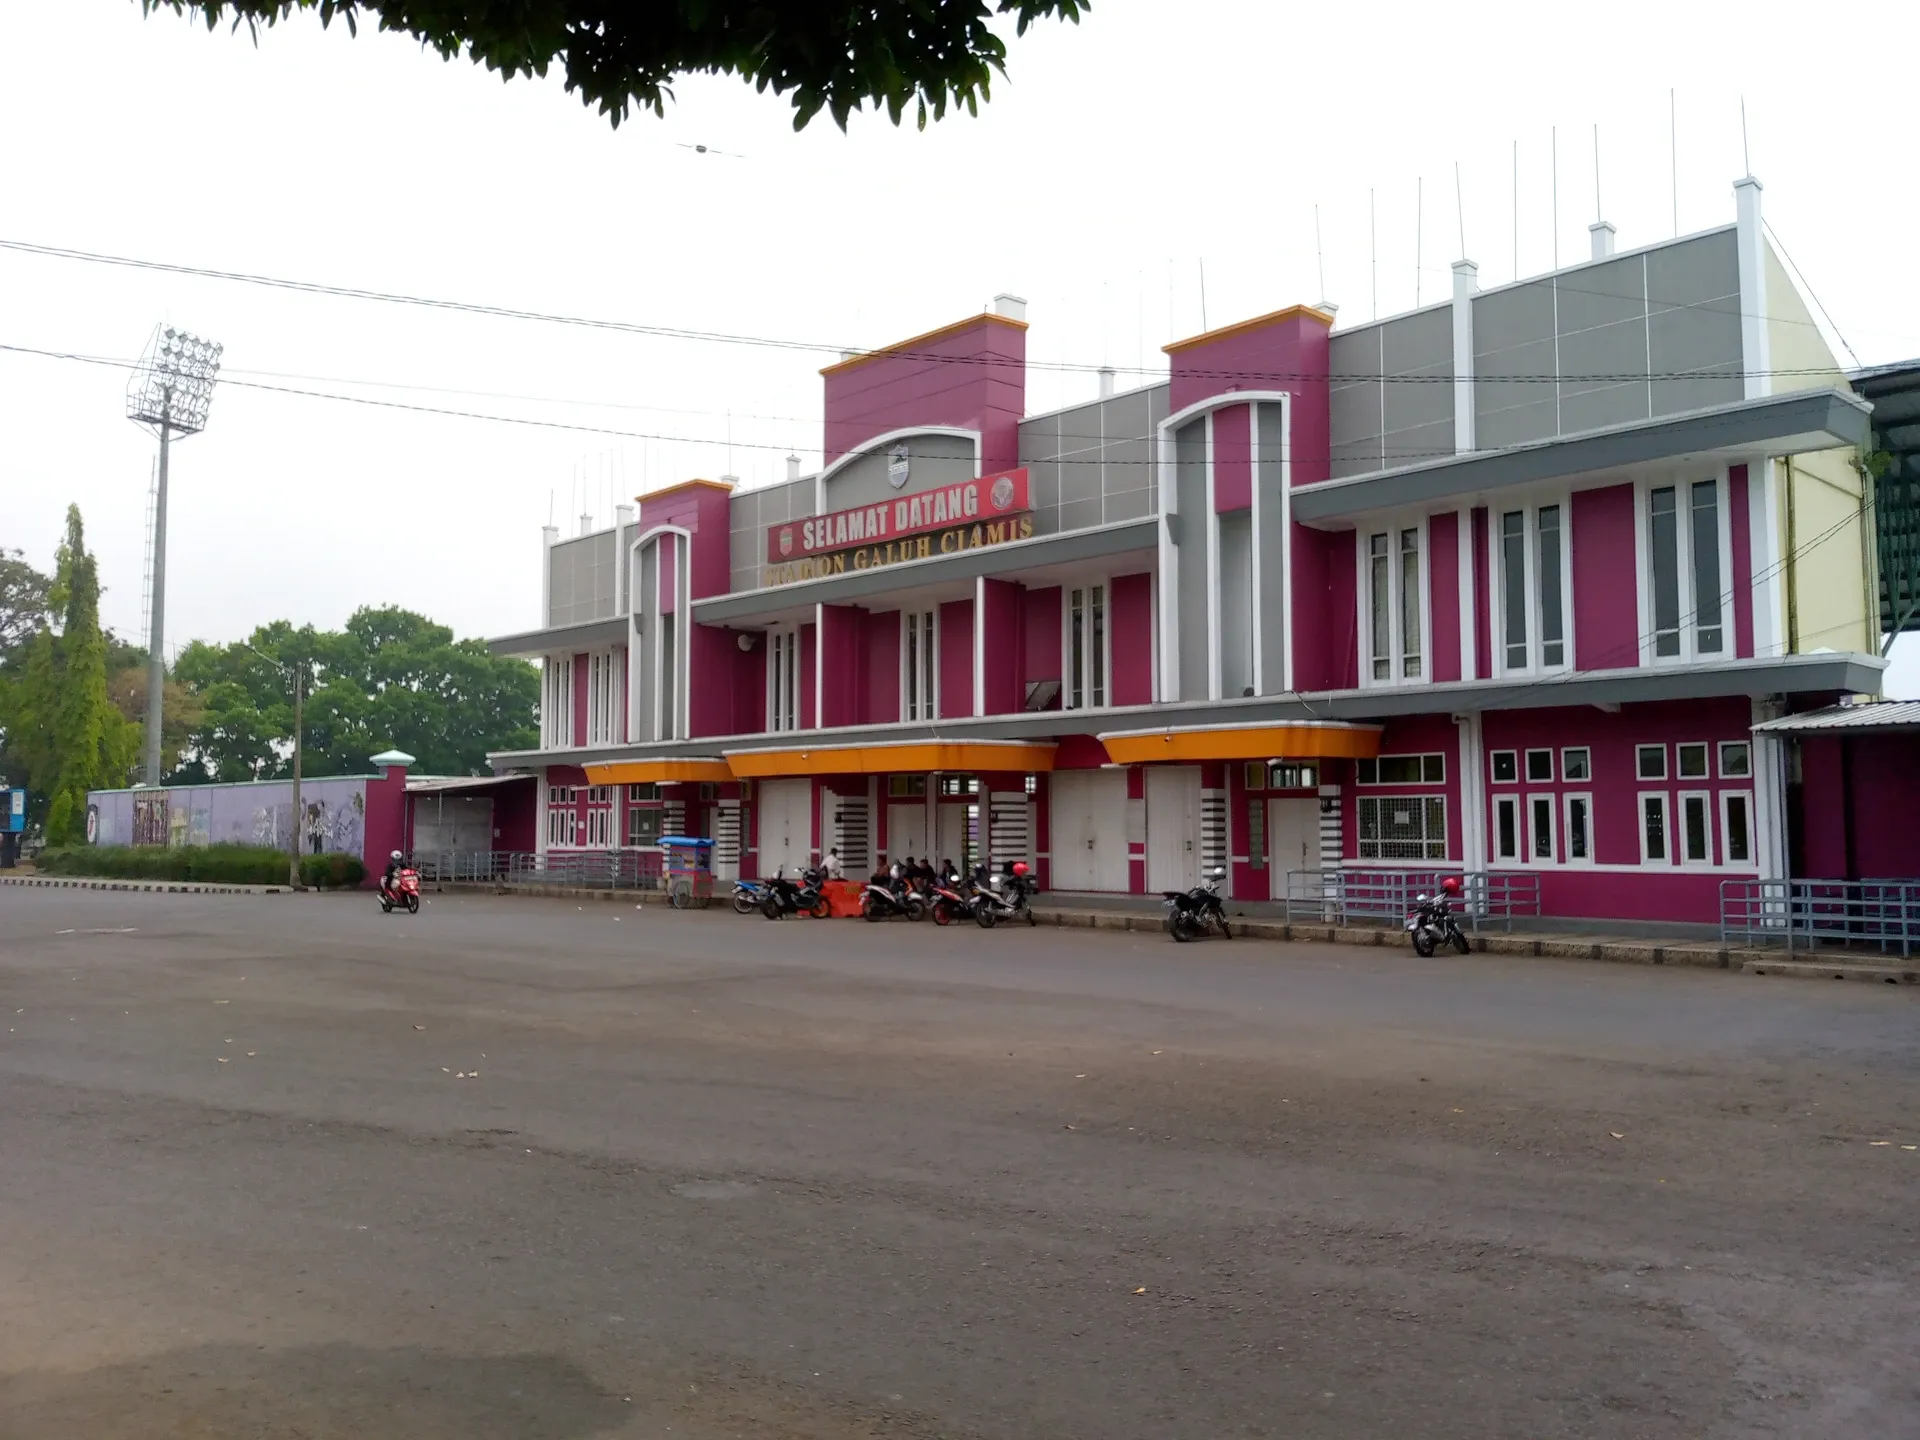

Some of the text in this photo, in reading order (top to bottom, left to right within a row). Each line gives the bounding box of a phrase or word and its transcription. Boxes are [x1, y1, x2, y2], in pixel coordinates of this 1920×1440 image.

[803, 485, 978, 550] SELAMAT DATANG
[854, 537, 931, 570] GALUH
[941, 516, 1032, 553] CIAMIS
